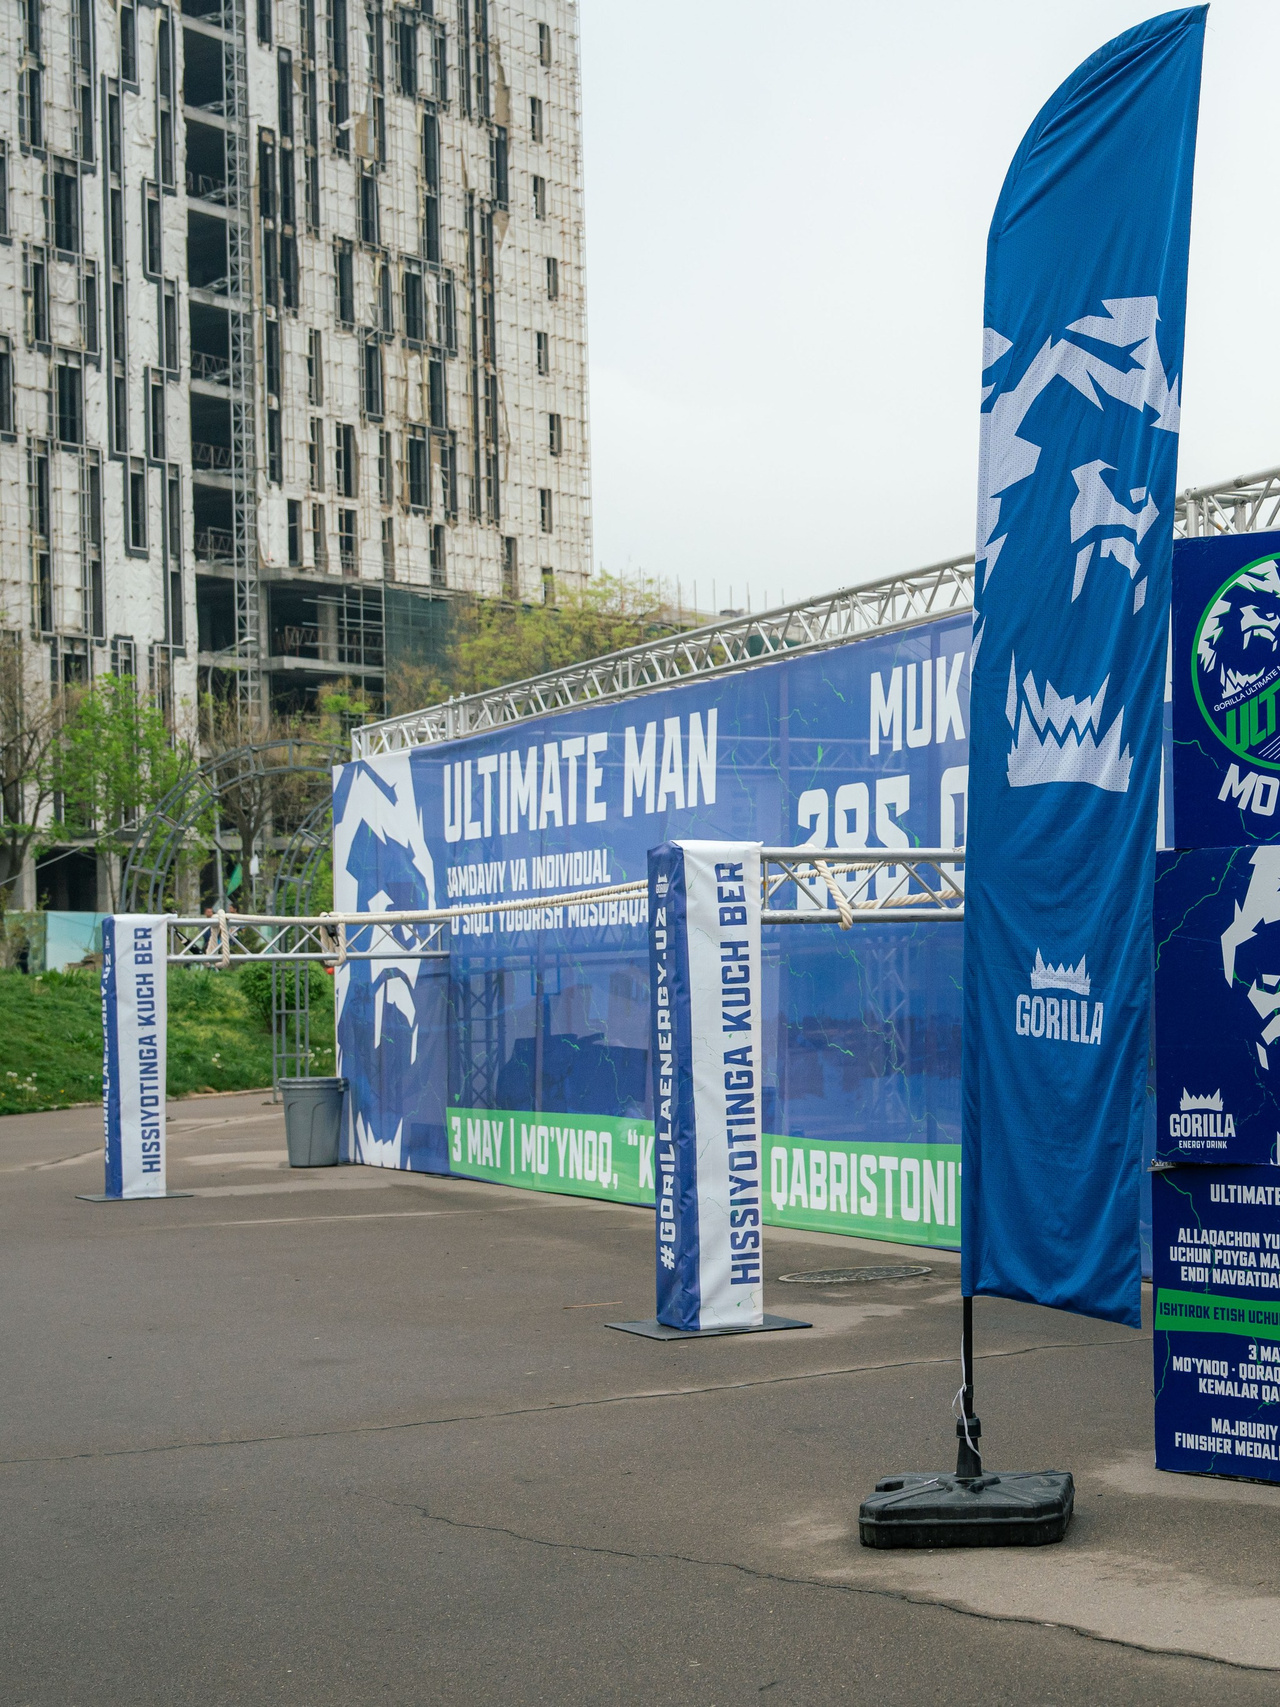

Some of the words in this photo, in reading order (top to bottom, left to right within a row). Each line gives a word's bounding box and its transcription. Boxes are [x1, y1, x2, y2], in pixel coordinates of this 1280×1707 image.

[869, 651, 966, 756] MUK
[1213, 692, 1246, 712] GORILLA
[1245, 670, 1278, 696] ULTIMATE
[443, 731, 608, 843] ULTIMATE
[623, 707, 718, 818] MAN
[796, 774, 910, 910] 285
[509, 858, 528, 892] VA
[532, 848, 612, 890] INDIVIDUAL
[449, 901, 494, 937] O'SIQLI
[497, 895, 564, 933] YUGURISH
[567, 887, 649, 928] MUSOBAQA
[715, 860, 749, 927] BER
[134, 926, 153, 966] BER
[135, 972, 157, 1028] KUCH
[719, 940, 753, 1033] KUCH
[1015, 993, 1104, 1045] GORILLA
[139, 1033, 161, 1174] HISSIYOTINGA
[655, 906, 677, 1271] #GORILLAENERGY.UZ
[451, 1116, 462, 1163] 3
[466, 1118, 504, 1168] MAY
[1169, 1113, 1237, 1138] GORILLA
[1178, 1139, 1206, 1149] ENERGY
[1206, 1140, 1228, 1149] DRINK
[723, 1045, 760, 1286] HISSIYOTINGA
[1169, 1246, 1212, 1265] UCHUN
[1214, 1250, 1257, 1268] POYGA
[1177, 1227, 1261, 1249] ALLAQACHON
[1180, 1265, 1210, 1283] ENDI
[1159, 1302, 1211, 1320] ISHTIROK
[1213, 1306, 1246, 1323] ETISH
[1248, 1344, 1258, 1361] 3
[1198, 1377, 1259, 1400] KEMALAR
[1174, 1431, 1232, 1455] FINISHER
[1210, 1417, 1279, 1442] MAJBURIY
